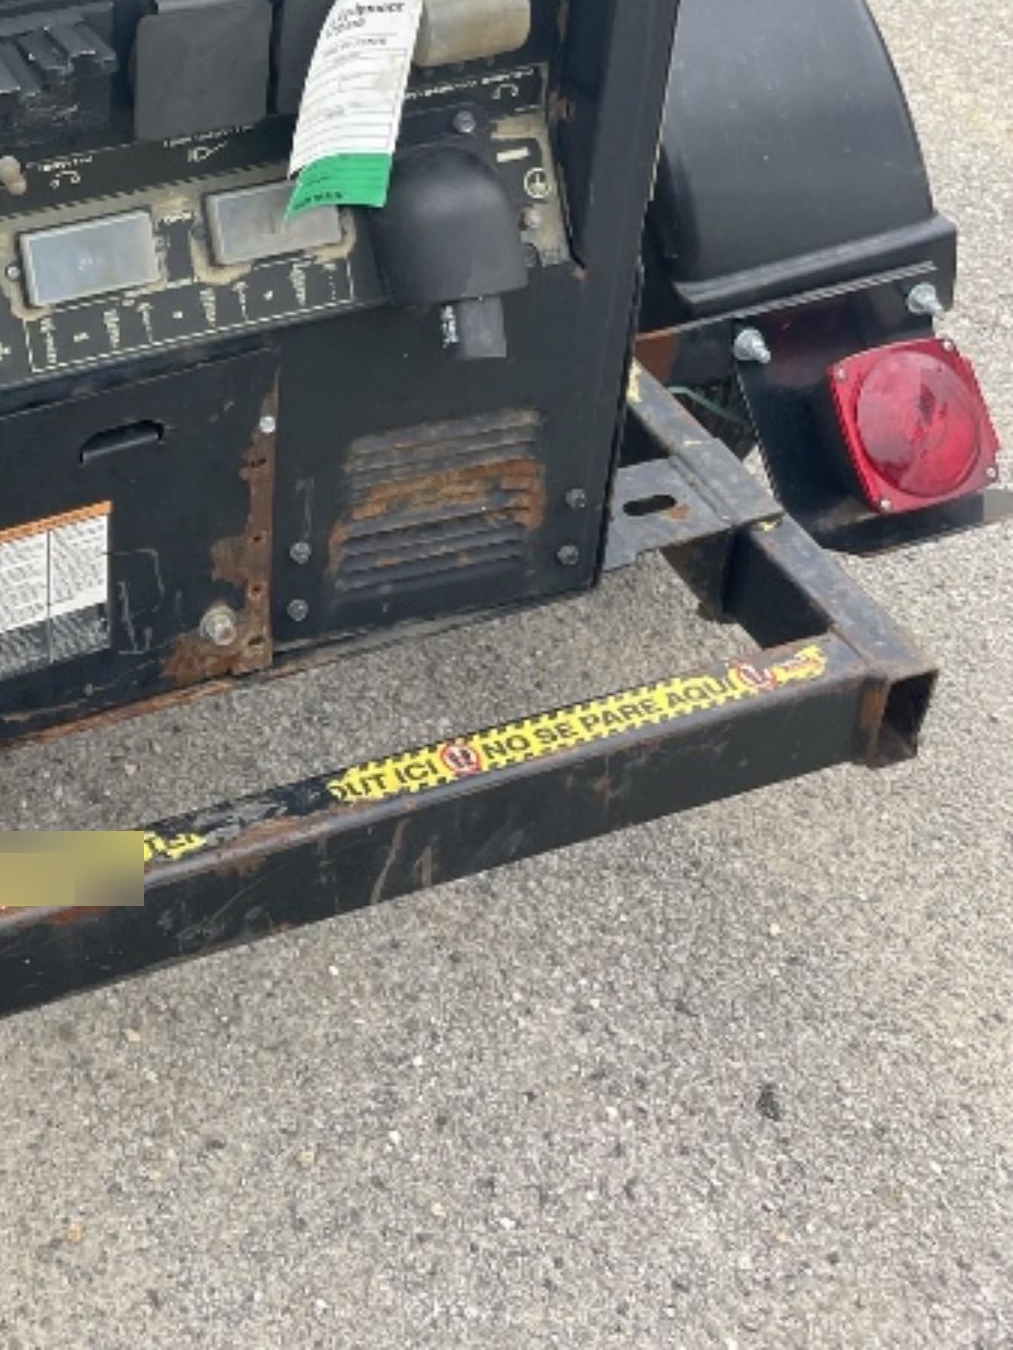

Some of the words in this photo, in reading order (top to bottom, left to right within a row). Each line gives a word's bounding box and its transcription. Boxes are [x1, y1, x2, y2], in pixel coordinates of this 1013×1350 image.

[395, 758, 438, 783] ICI
[482, 733, 531, 760] NO
[534, 721, 577, 745] SE
[581, 698, 663, 732] PARE
